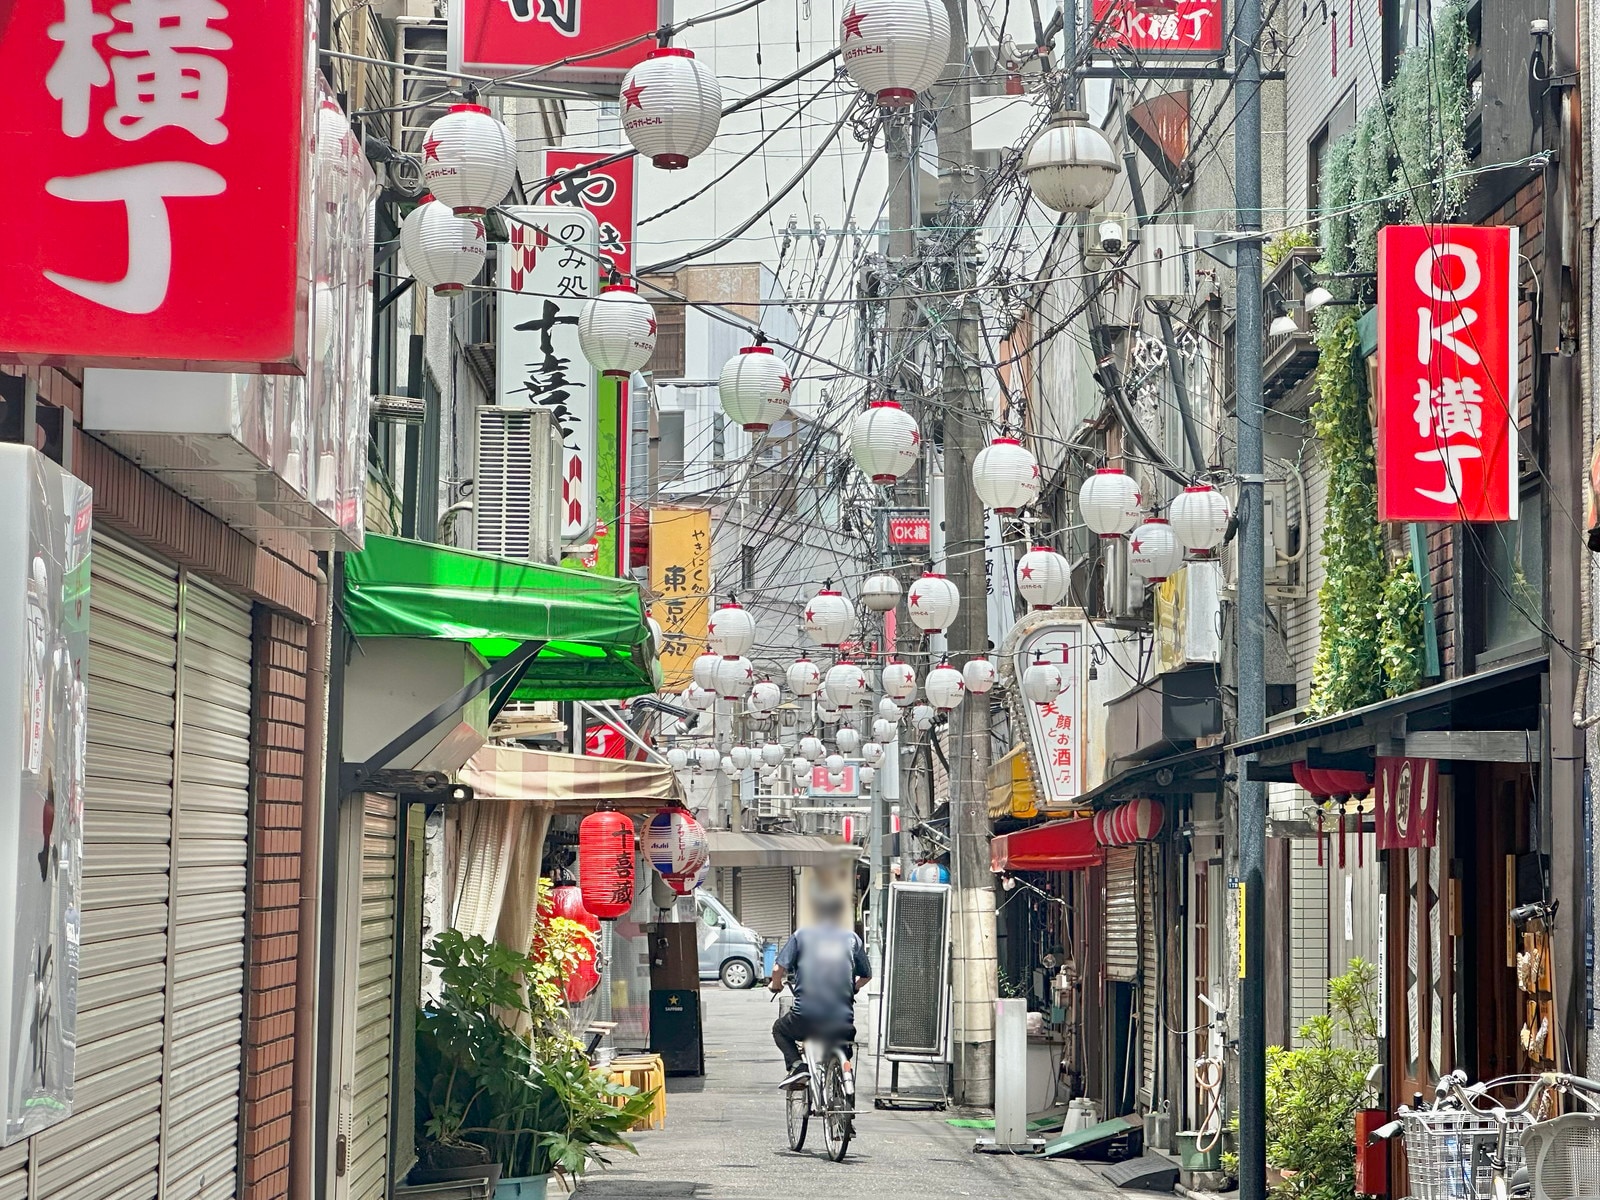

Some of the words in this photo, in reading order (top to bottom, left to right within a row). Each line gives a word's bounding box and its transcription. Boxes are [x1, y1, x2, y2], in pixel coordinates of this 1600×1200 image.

[557, 224, 588, 297] のみ処
[1414, 243, 1484, 504] OK横丁
[692, 530, 705, 594] やきにく処
[894, 525, 930, 540] OK横
[610, 822, 633, 905] 十喜蔵
